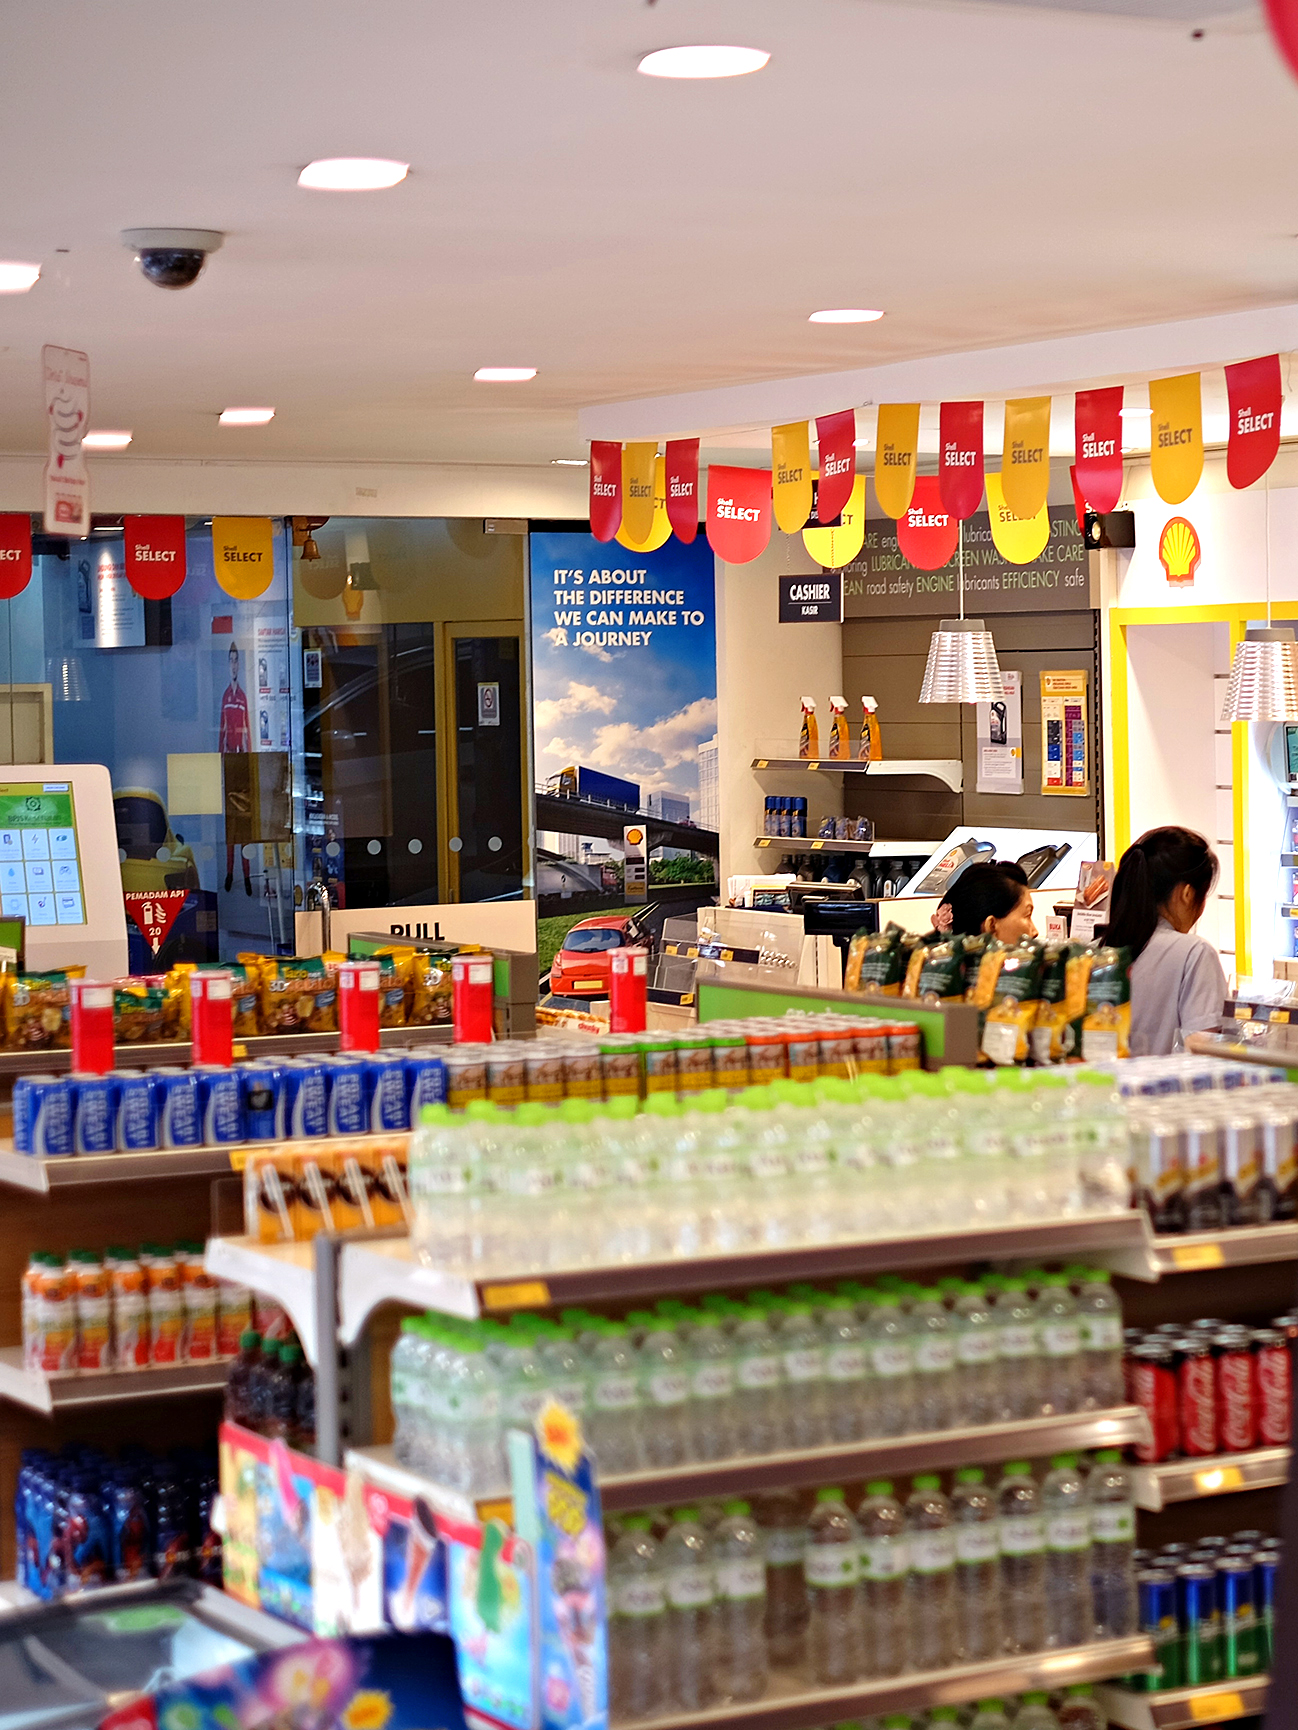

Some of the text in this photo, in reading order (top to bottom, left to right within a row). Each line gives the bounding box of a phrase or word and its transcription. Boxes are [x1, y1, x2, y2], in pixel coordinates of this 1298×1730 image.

[1238, 407, 1251, 418] Shell
[1238, 413, 1274, 435] SELECT
[1083, 433, 1095, 442] Shell
[1158, 428, 1192, 448] SELECT
[945, 442, 957, 450] Shell
[1083, 440, 1115, 458] SELECT
[825, 453, 835, 462] Shell
[884, 452, 911, 465] SELECT
[945, 451, 976, 466] SELECT
[1012, 449, 1043, 464] SELECT
[825, 458, 850, 477] SELECT
[778, 469, 802, 484] SELECT
[593, 483, 616, 496] SELECT
[630, 485, 651, 497] SELECT
[671, 483, 693, 496] SELECT
[717, 498, 733, 506] Shell
[717, 506, 760, 521] SELECT
[908, 515, 948, 527] SELECT
[135, 551, 176, 562] SELECT
[224, 552, 262, 562] SELECT
[1057, 543, 1084, 561] CARE
[554, 570, 647, 584] IT'S ABOUT
[867, 567, 1084, 598] road safety ENGINE lbricants EFFICIENCY safe
[554, 591, 684, 605] THE DIFFERENCE
[790, 583, 830, 601] CASHIER
[801, 605, 818, 615] KASIR
[554, 612, 704, 625] WE CAN MAKE TO
[554, 632, 652, 646] A JOURNEY
[126, 890, 184, 901] PEMADAM API
[149, 927, 161, 936] 20
